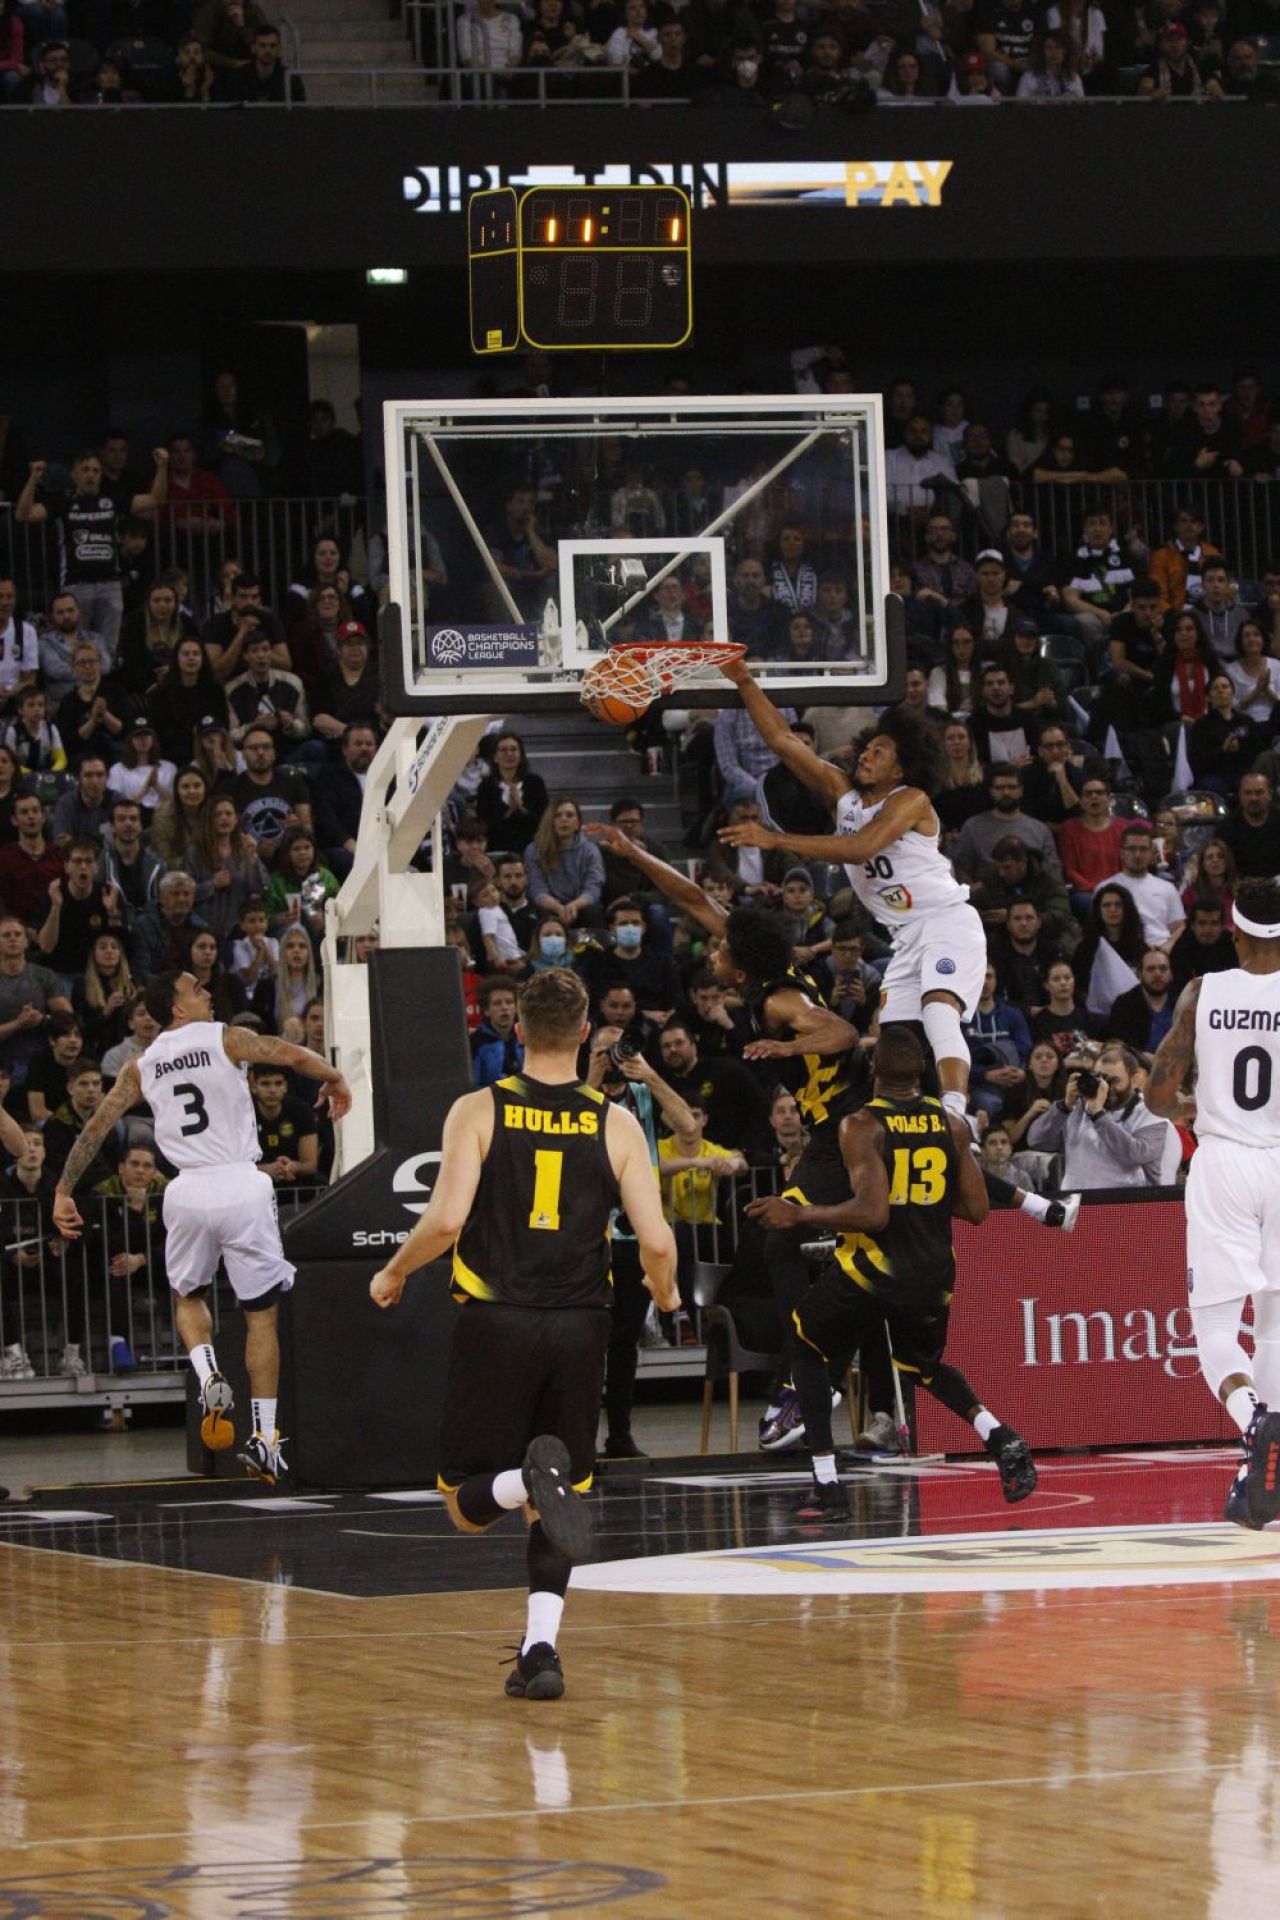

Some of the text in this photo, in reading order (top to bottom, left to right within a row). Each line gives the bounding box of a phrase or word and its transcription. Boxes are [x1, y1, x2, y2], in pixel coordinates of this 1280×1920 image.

[845, 160, 954, 207] PAY
[467, 633, 527, 641] BASKETBALL
[467, 640, 535, 651] CHAMPIONS
[467, 651, 505, 660] LEAGUE
[154, 1051, 212, 1080] BROWN
[1233, 1045, 1273, 1112] 0
[173, 1082, 209, 1137] 3
[503, 1104, 599, 1135] HULLS
[930, 1114, 946, 1133] B.
[529, 1149, 563, 1231] 1
[888, 1146, 947, 1206] 13
